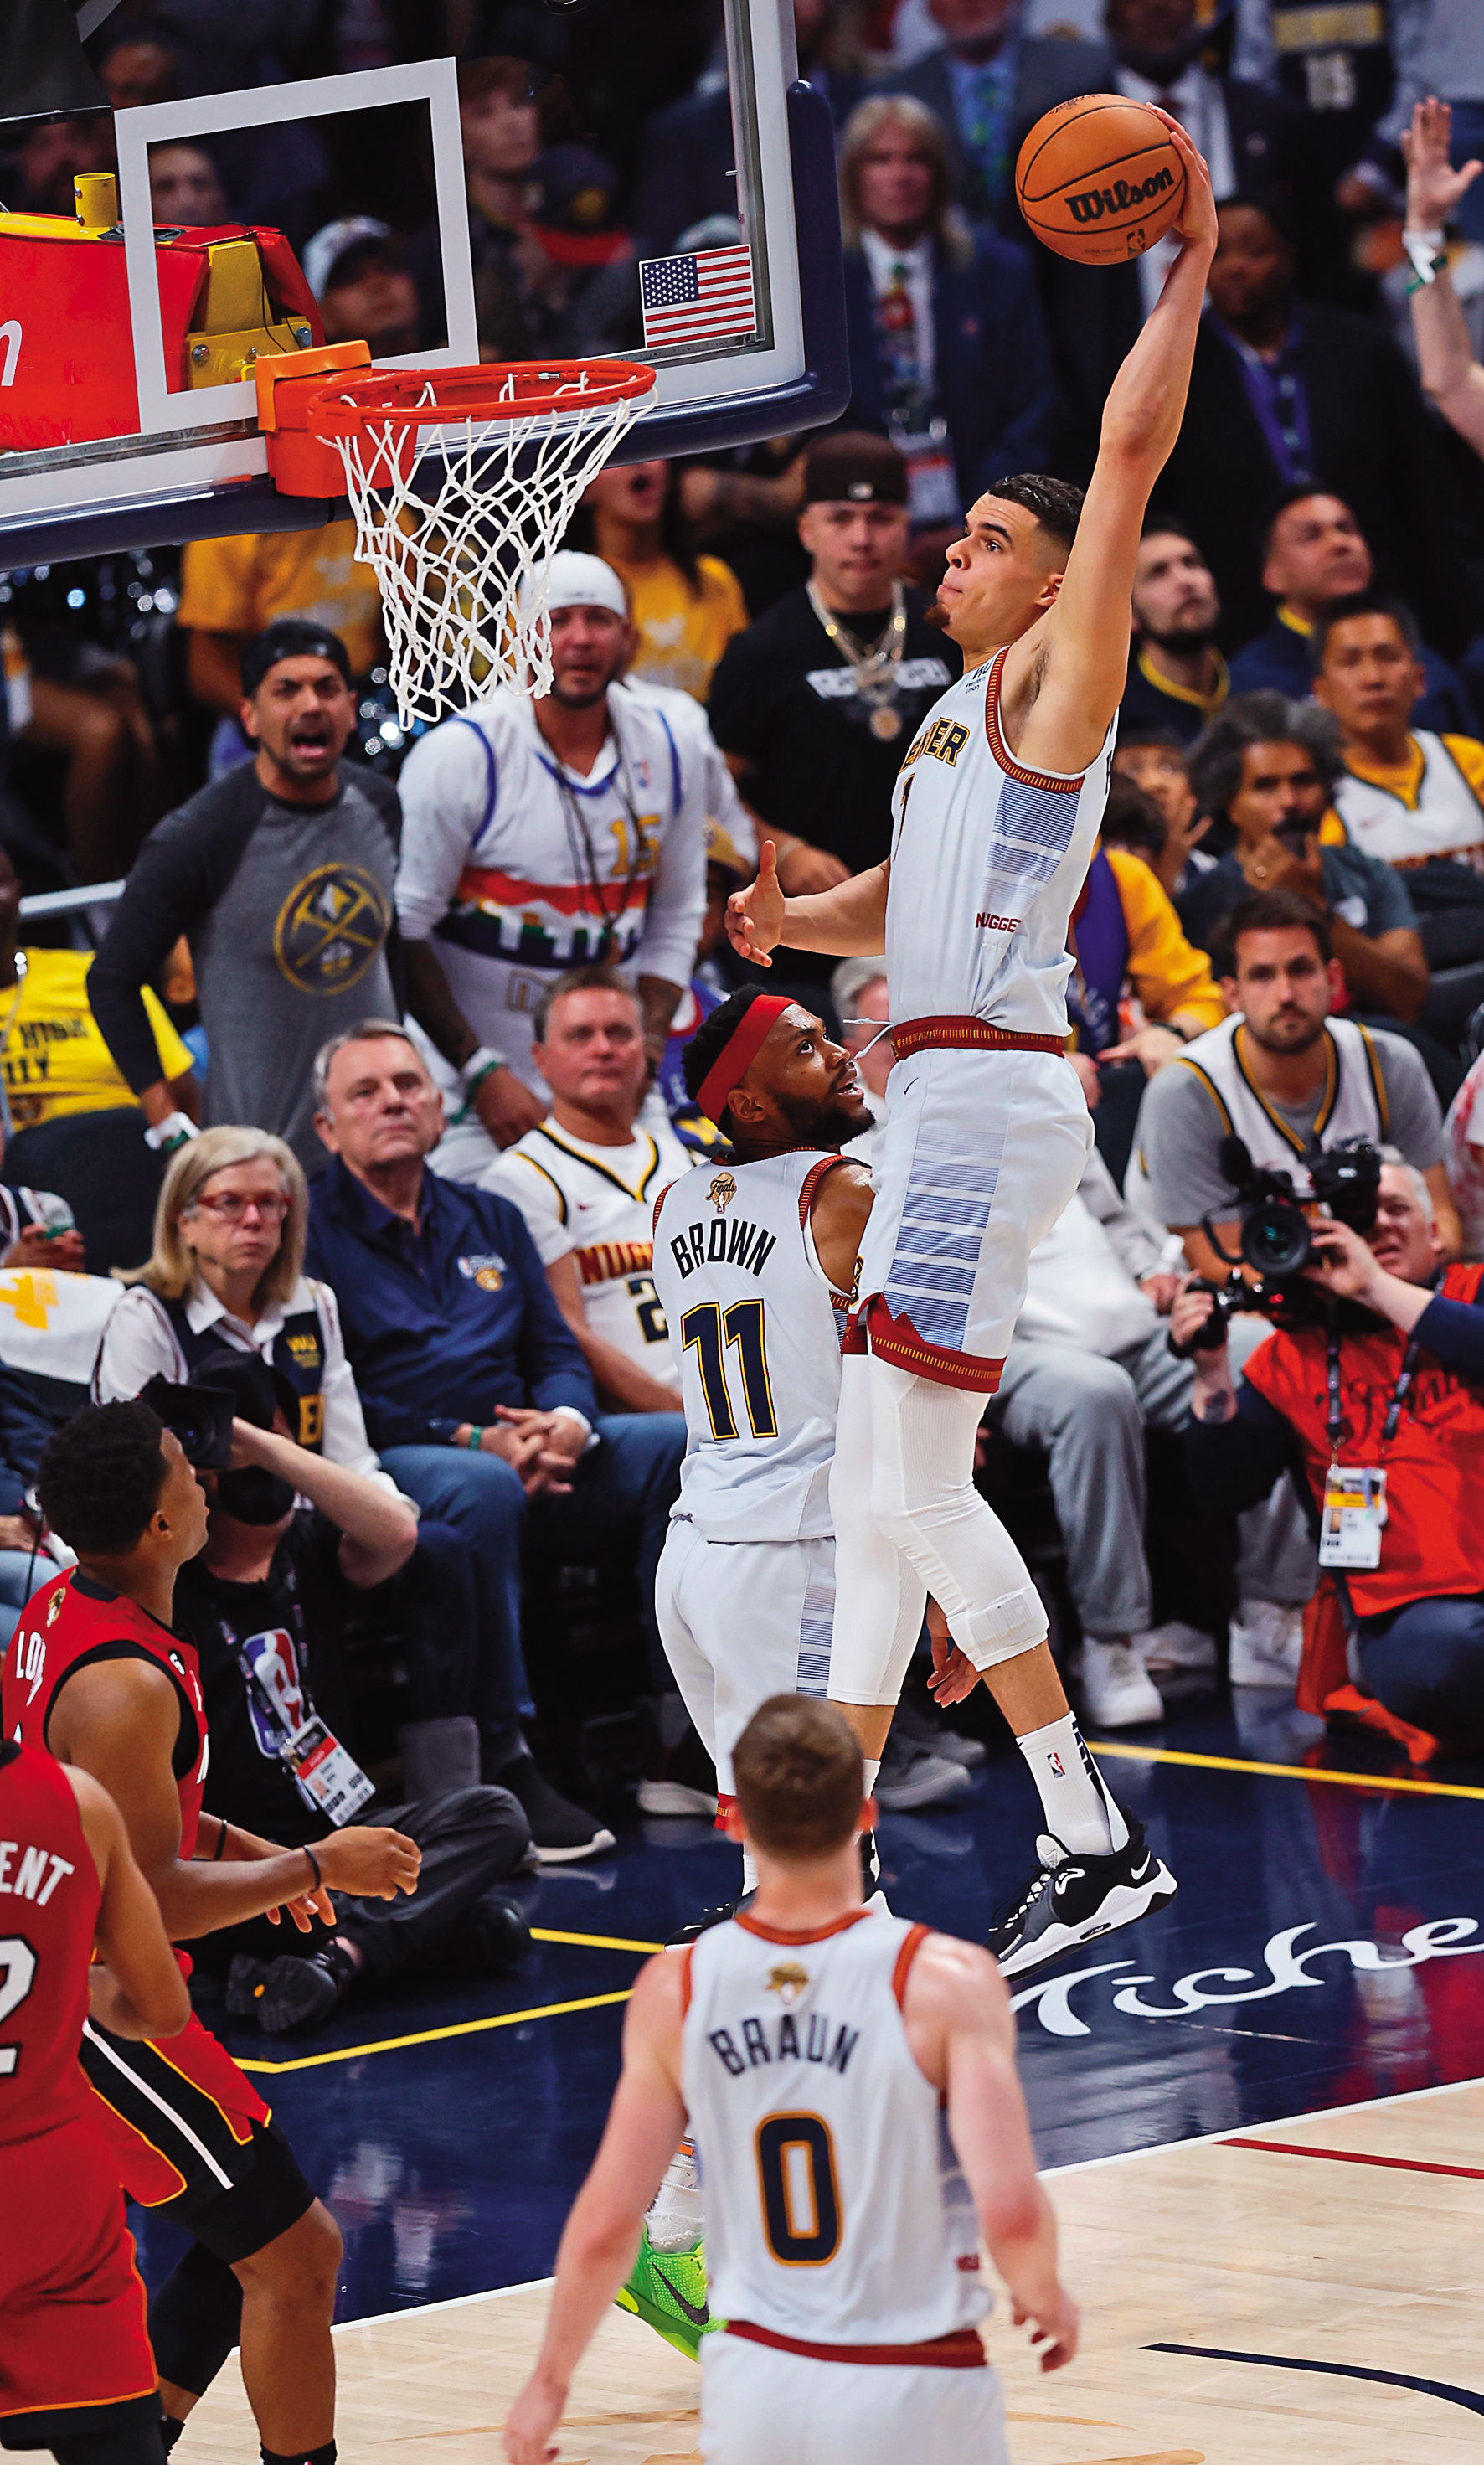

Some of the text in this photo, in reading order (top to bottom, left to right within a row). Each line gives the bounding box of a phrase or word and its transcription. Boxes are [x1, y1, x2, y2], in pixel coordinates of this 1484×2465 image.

[1064, 167, 1174, 224] Wilson
[611, 814, 661, 875] 15
[706, 1178, 737, 1201] Finals
[670, 1218, 777, 1280] BROWN
[680, 1298, 779, 1441] 11
[708, 2013, 860, 2076] BRAUN
[754, 2110, 844, 2267] 0
